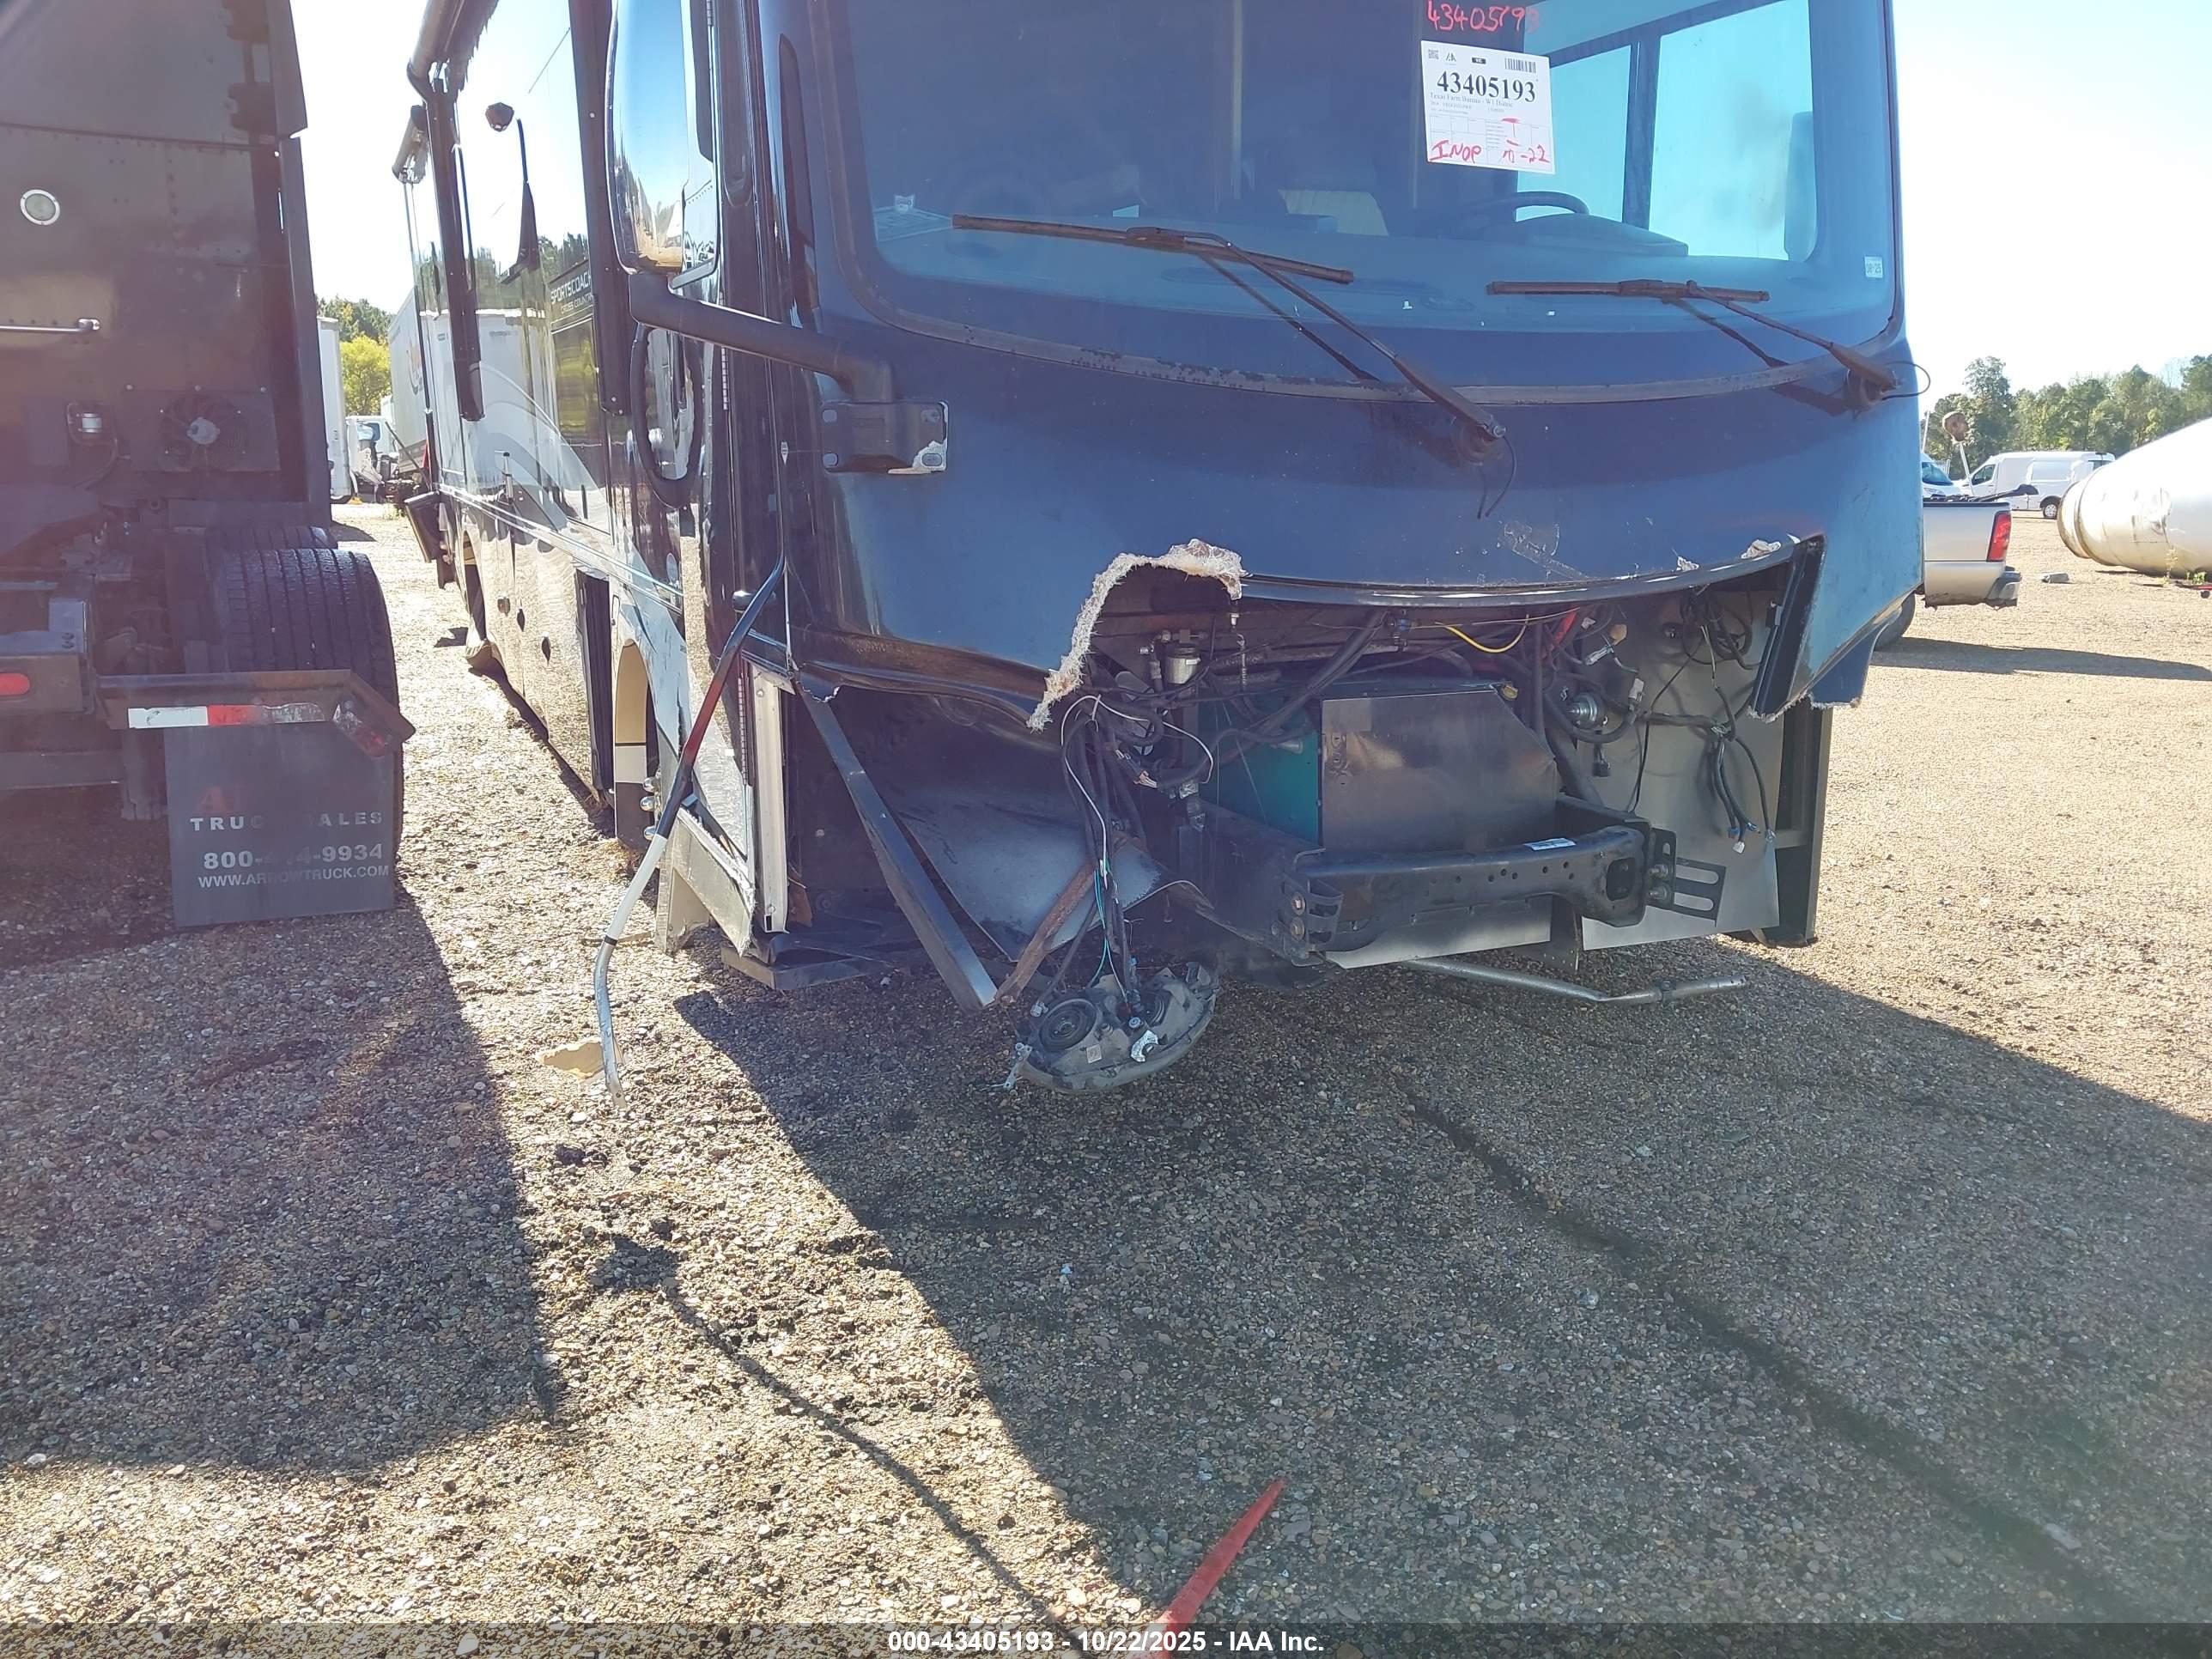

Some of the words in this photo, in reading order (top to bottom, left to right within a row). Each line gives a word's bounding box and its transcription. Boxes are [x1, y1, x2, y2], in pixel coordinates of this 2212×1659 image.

[1437, 70, 1535, 102] 43405193
[1430, 140, 1482, 164] INOP
[190, 815, 264, 831] TRUC
[307, 811, 383, 828] ALES
